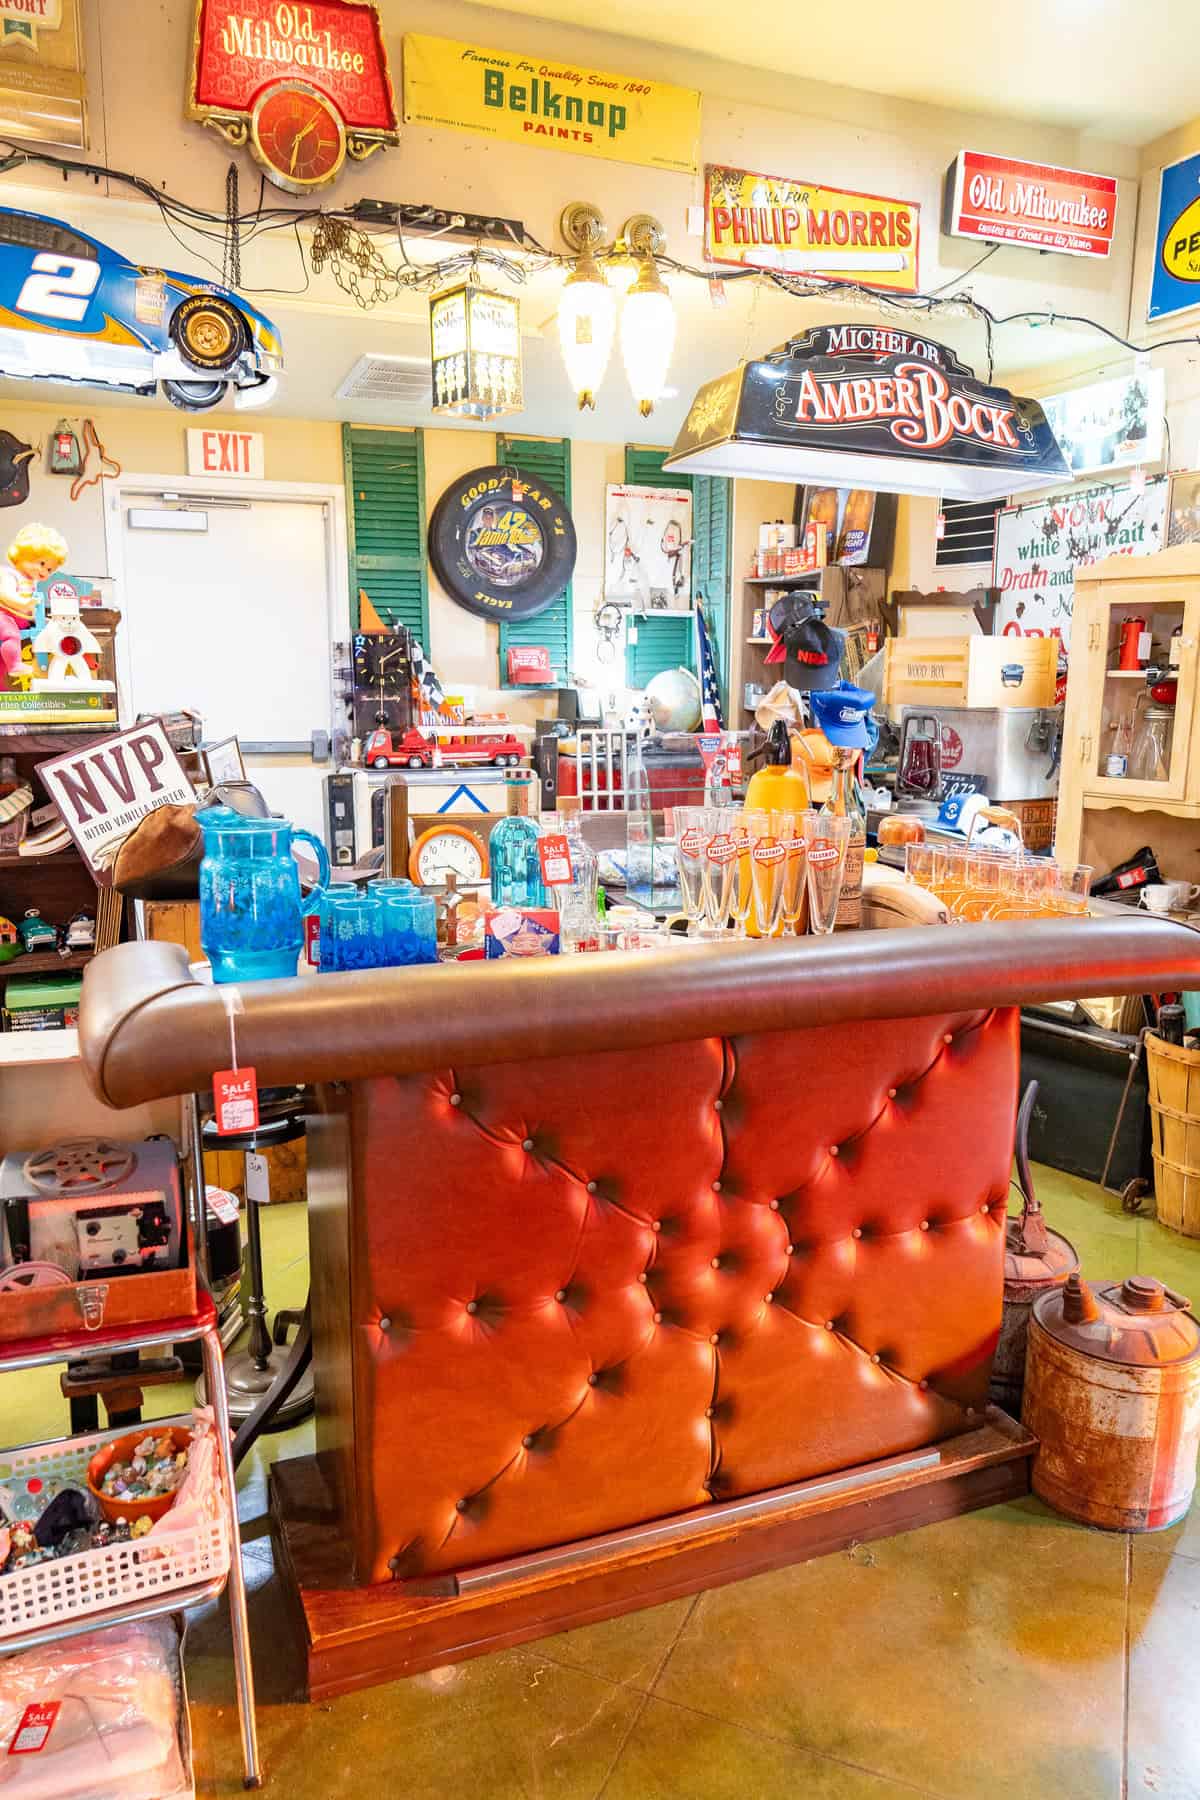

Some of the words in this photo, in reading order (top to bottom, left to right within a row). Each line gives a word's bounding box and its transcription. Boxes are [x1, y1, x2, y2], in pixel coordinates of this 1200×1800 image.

[276, 4, 320, 42] Old
[221, 15, 364, 74] Milwaukee
[461, 50, 510, 68] Famous
[516, 62, 535, 72] For
[539, 66, 583, 87] Quality
[588, 75, 618, 89] Since
[623, 82, 651, 95] 1840
[484, 69, 626, 137] Belknap
[523, 121, 593, 143] PAINTS
[786, 191, 810, 205] FOR
[969, 175, 1005, 212] Old
[1010, 183, 1108, 229] Milwaukee
[712, 206, 799, 245] PHILIP
[807, 209, 912, 247] MORRIS
[1017, 227, 1042, 241] Great
[15, 252, 101, 321] 2
[826, 326, 941, 365] MICHELOB
[795, 369, 923, 423] AMBER
[889, 361, 1020, 449] BOCK
[202, 432, 253, 473] EXIT
[461, 477, 552, 511] GOODYEAR
[498, 511, 528, 531] 42
[1050, 500, 1112, 529] NOW
[844, 538, 865, 547] IGHT
[1017, 536, 1060, 561] while
[1066, 532, 1098, 560] you
[1104, 520, 1145, 546] wait
[1000, 566, 1048, 593] Drain
[1050, 564, 1073, 587] and
[474, 591, 512, 609] EAGLE
[907, 664, 928, 679] WOOD
[930, 664, 945, 679] BOX
[21, 700, 65, 709] Collectibles
[53, 735, 164, 824] NVP
[83, 820, 113, 840] NITRO
[113, 804, 151, 826] VANILLA
[152, 789, 187, 807] PORTER
[451, 840, 460, 848] 12
[543, 843, 565, 854] SALE
[754, 846, 785, 858] FALSTAFF
[808, 849, 841, 860] FALSTAFF
[221, 1080, 251, 1096] SALE
[26, 1711, 53, 1722] SALE
